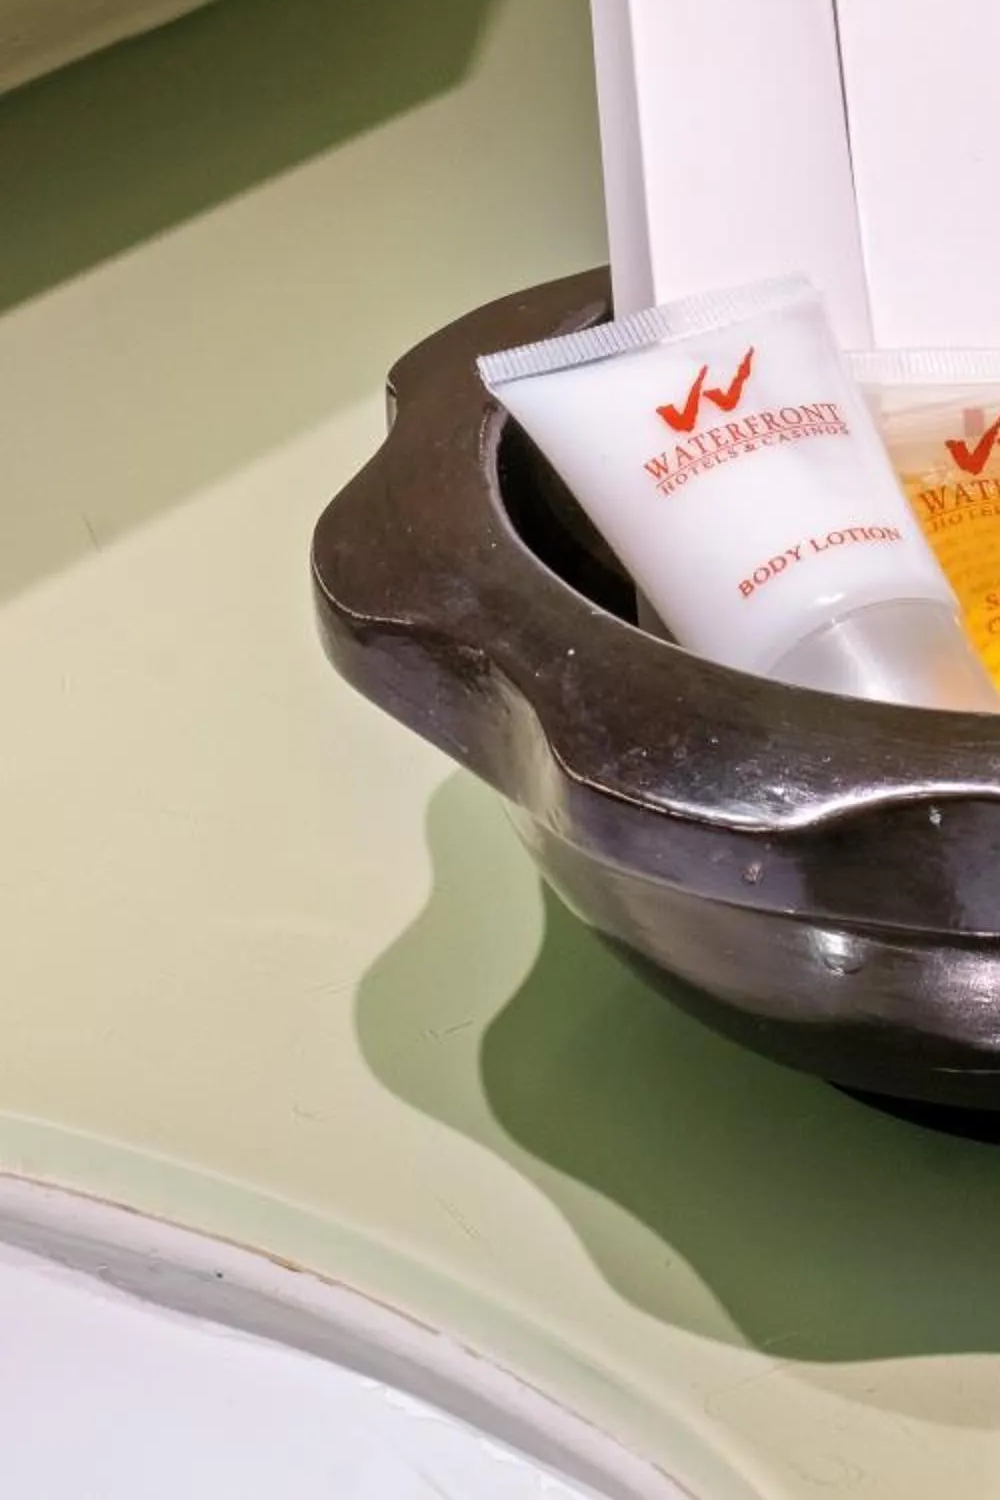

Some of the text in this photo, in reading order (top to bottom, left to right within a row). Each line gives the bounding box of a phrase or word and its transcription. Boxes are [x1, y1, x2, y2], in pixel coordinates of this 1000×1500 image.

[643, 402, 842, 480] WATERFRONT
[659, 422, 851, 497] HOTELS & CASINOS
[737, 525, 903, 598] BODY LOTION
